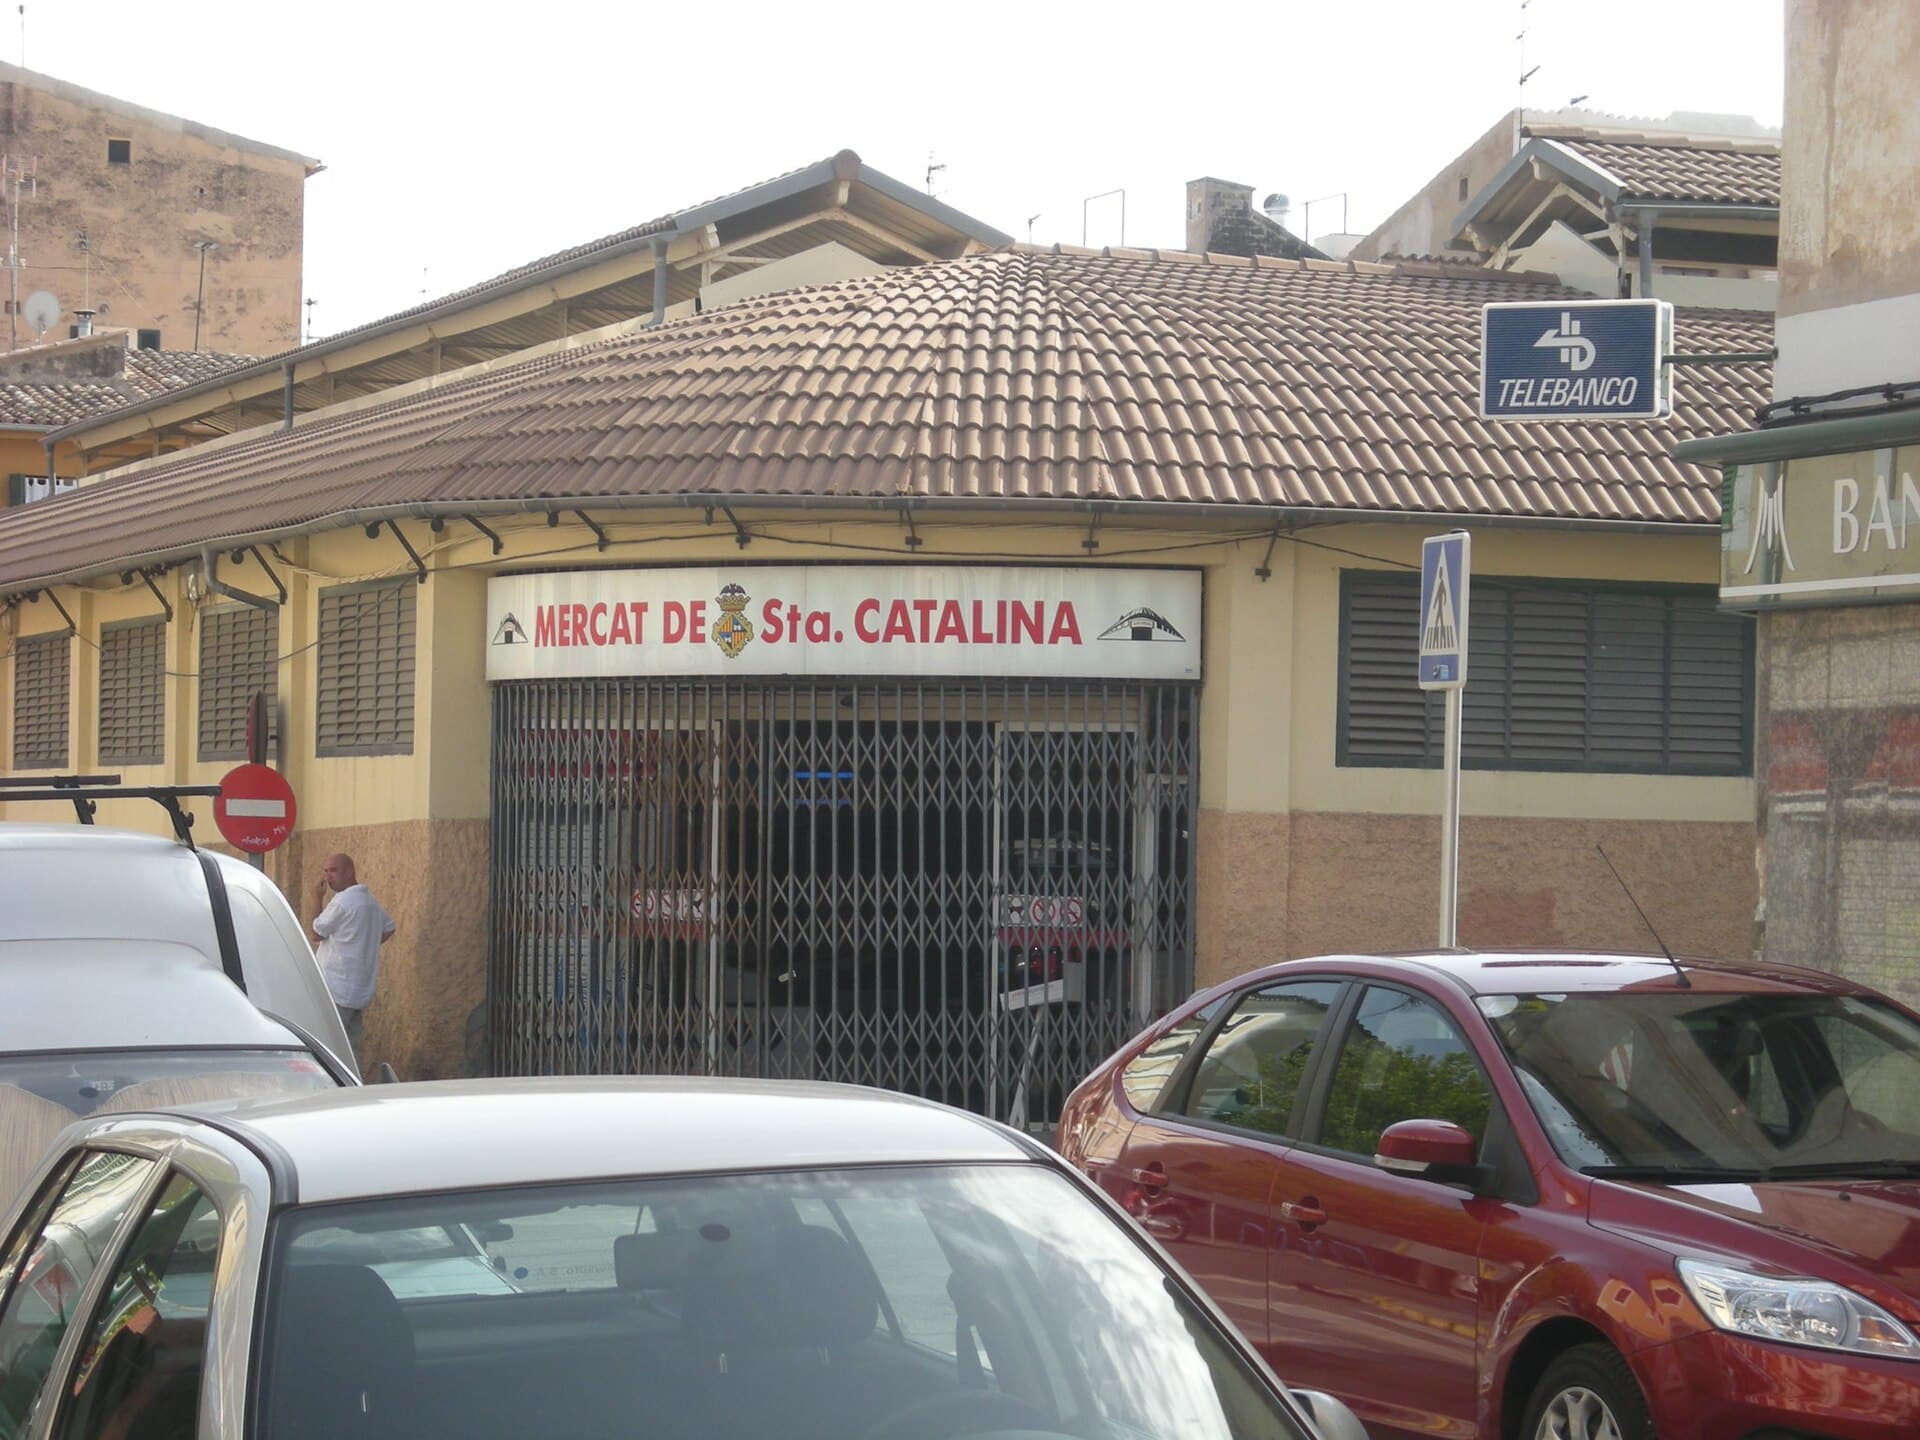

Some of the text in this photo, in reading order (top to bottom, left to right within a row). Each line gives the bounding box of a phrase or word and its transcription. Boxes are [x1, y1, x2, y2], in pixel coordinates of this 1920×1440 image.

[1498, 376, 1638, 408] TELEBANCO
[534, 599, 1082, 647] MERCAT DE Sta. CATALINA
